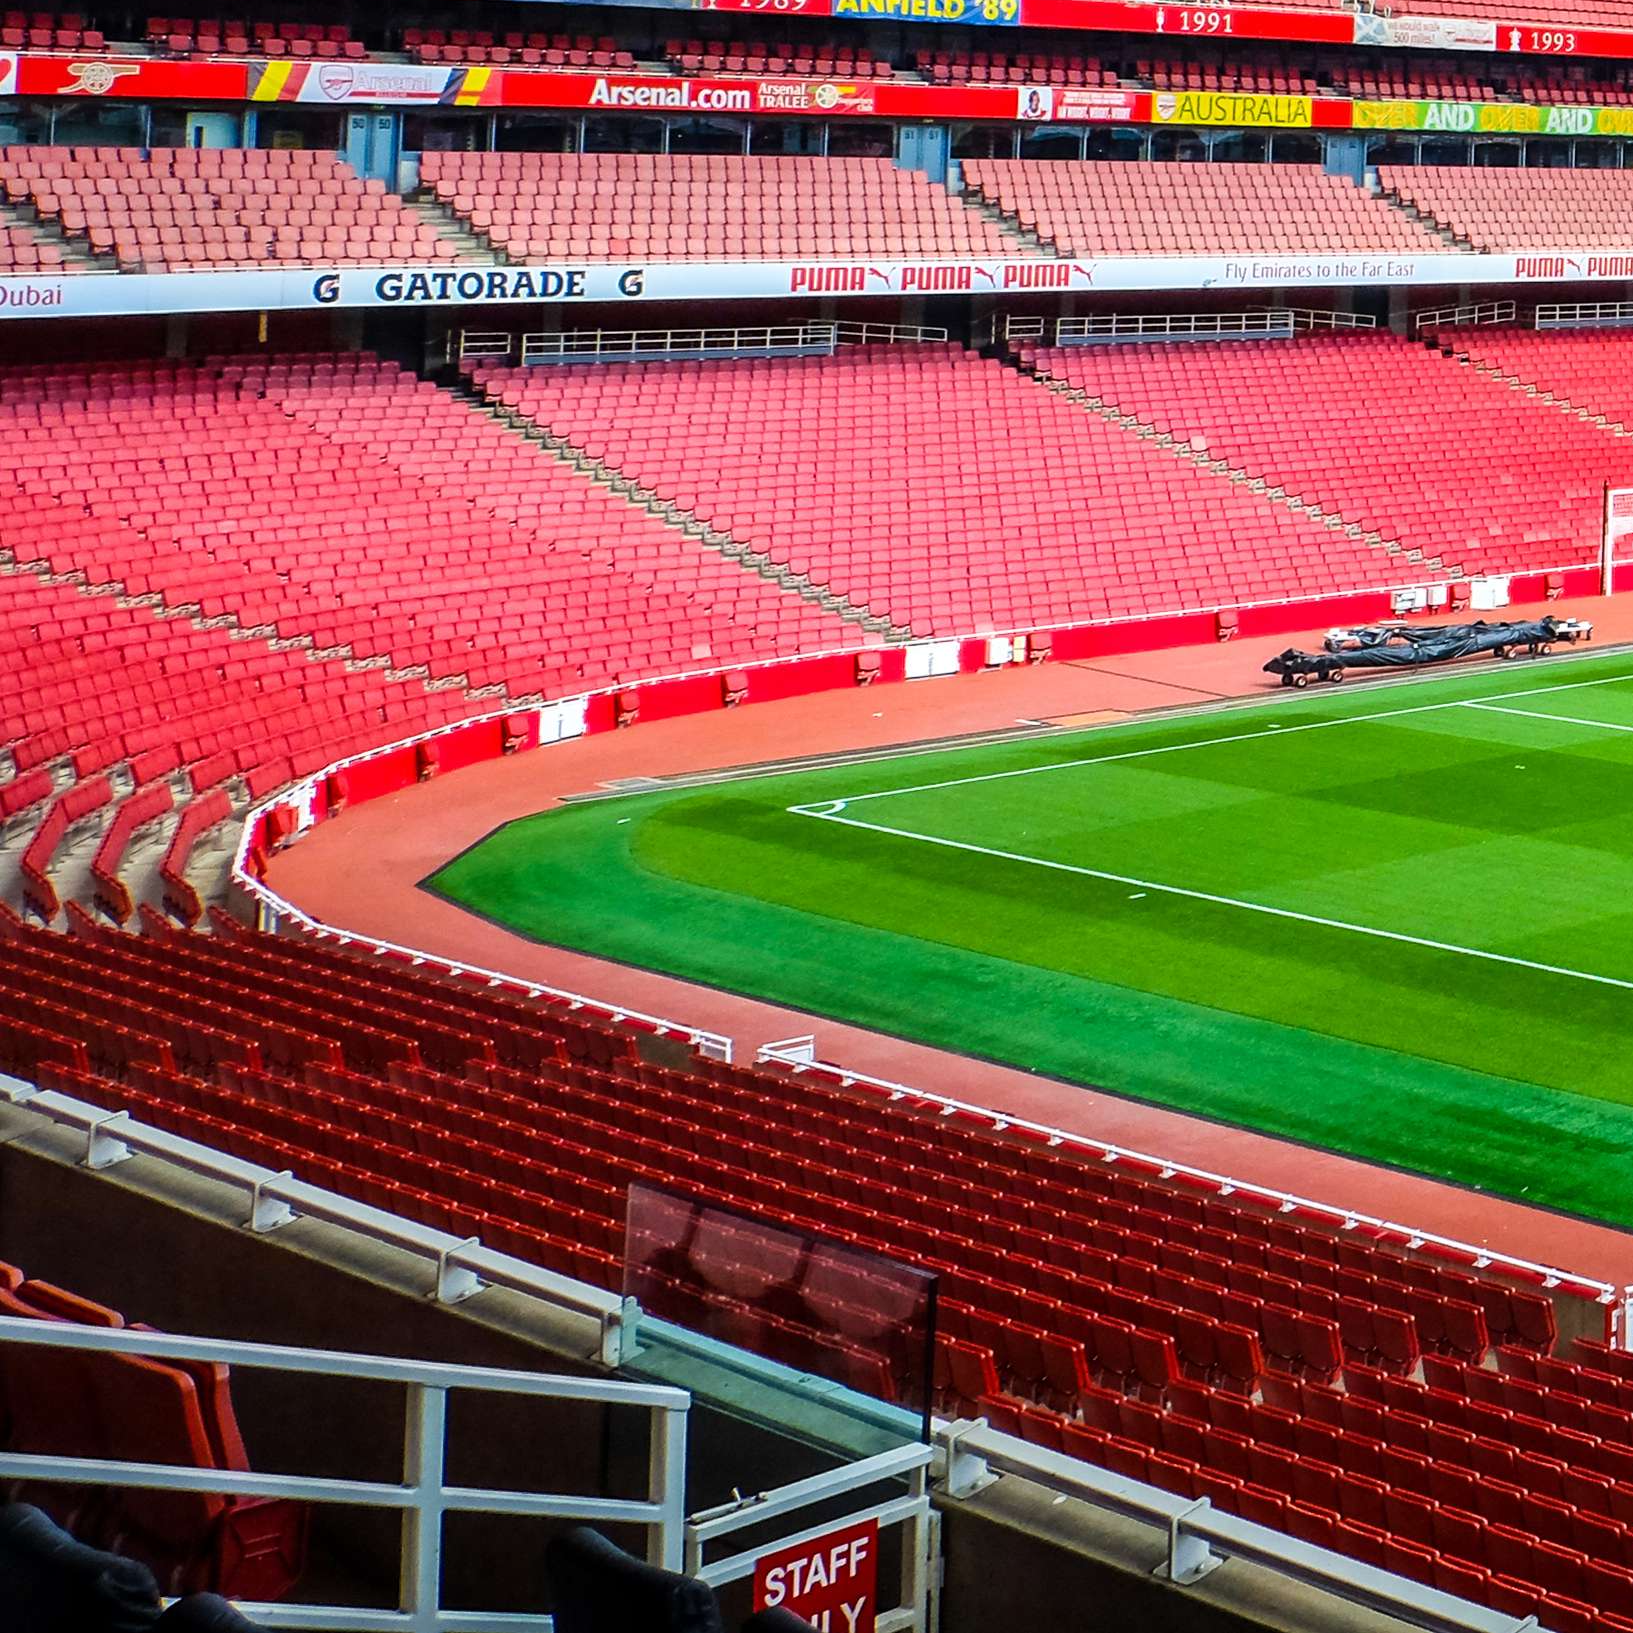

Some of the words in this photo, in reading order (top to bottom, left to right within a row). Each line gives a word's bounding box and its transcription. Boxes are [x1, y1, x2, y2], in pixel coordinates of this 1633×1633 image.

[1180, 11, 1234, 33] 1991
[1393, 32, 1410, 43] 500
[1531, 33, 1575, 51] 1993
[589, 78, 751, 110] Arsenal.com
[759, 82, 806, 96] Arsenal
[760, 95, 809, 109] TRALEE
[1179, 95, 1309, 123] AUSTRALIA
[1423, 103, 1475, 131] AND
[1545, 107, 1593, 135] AND
[791, 266, 865, 292] PUMA
[900, 265, 972, 291] PUMA
[1003, 264, 1070, 288] PUMA
[1225, 263, 1247, 282] Fly
[1252, 262, 1313, 279] Emirates
[1317, 263, 1331, 278] to
[1335, 261, 1358, 278] the
[1362, 261, 1383, 277] Far
[1387, 261, 1415, 277] East
[1515, 256, 1565, 278] PUMA
[1587, 255, 1633, 277] PUMA
[375, 270, 586, 302] GATORADE
[764, 1536, 870, 1608] STAFF
